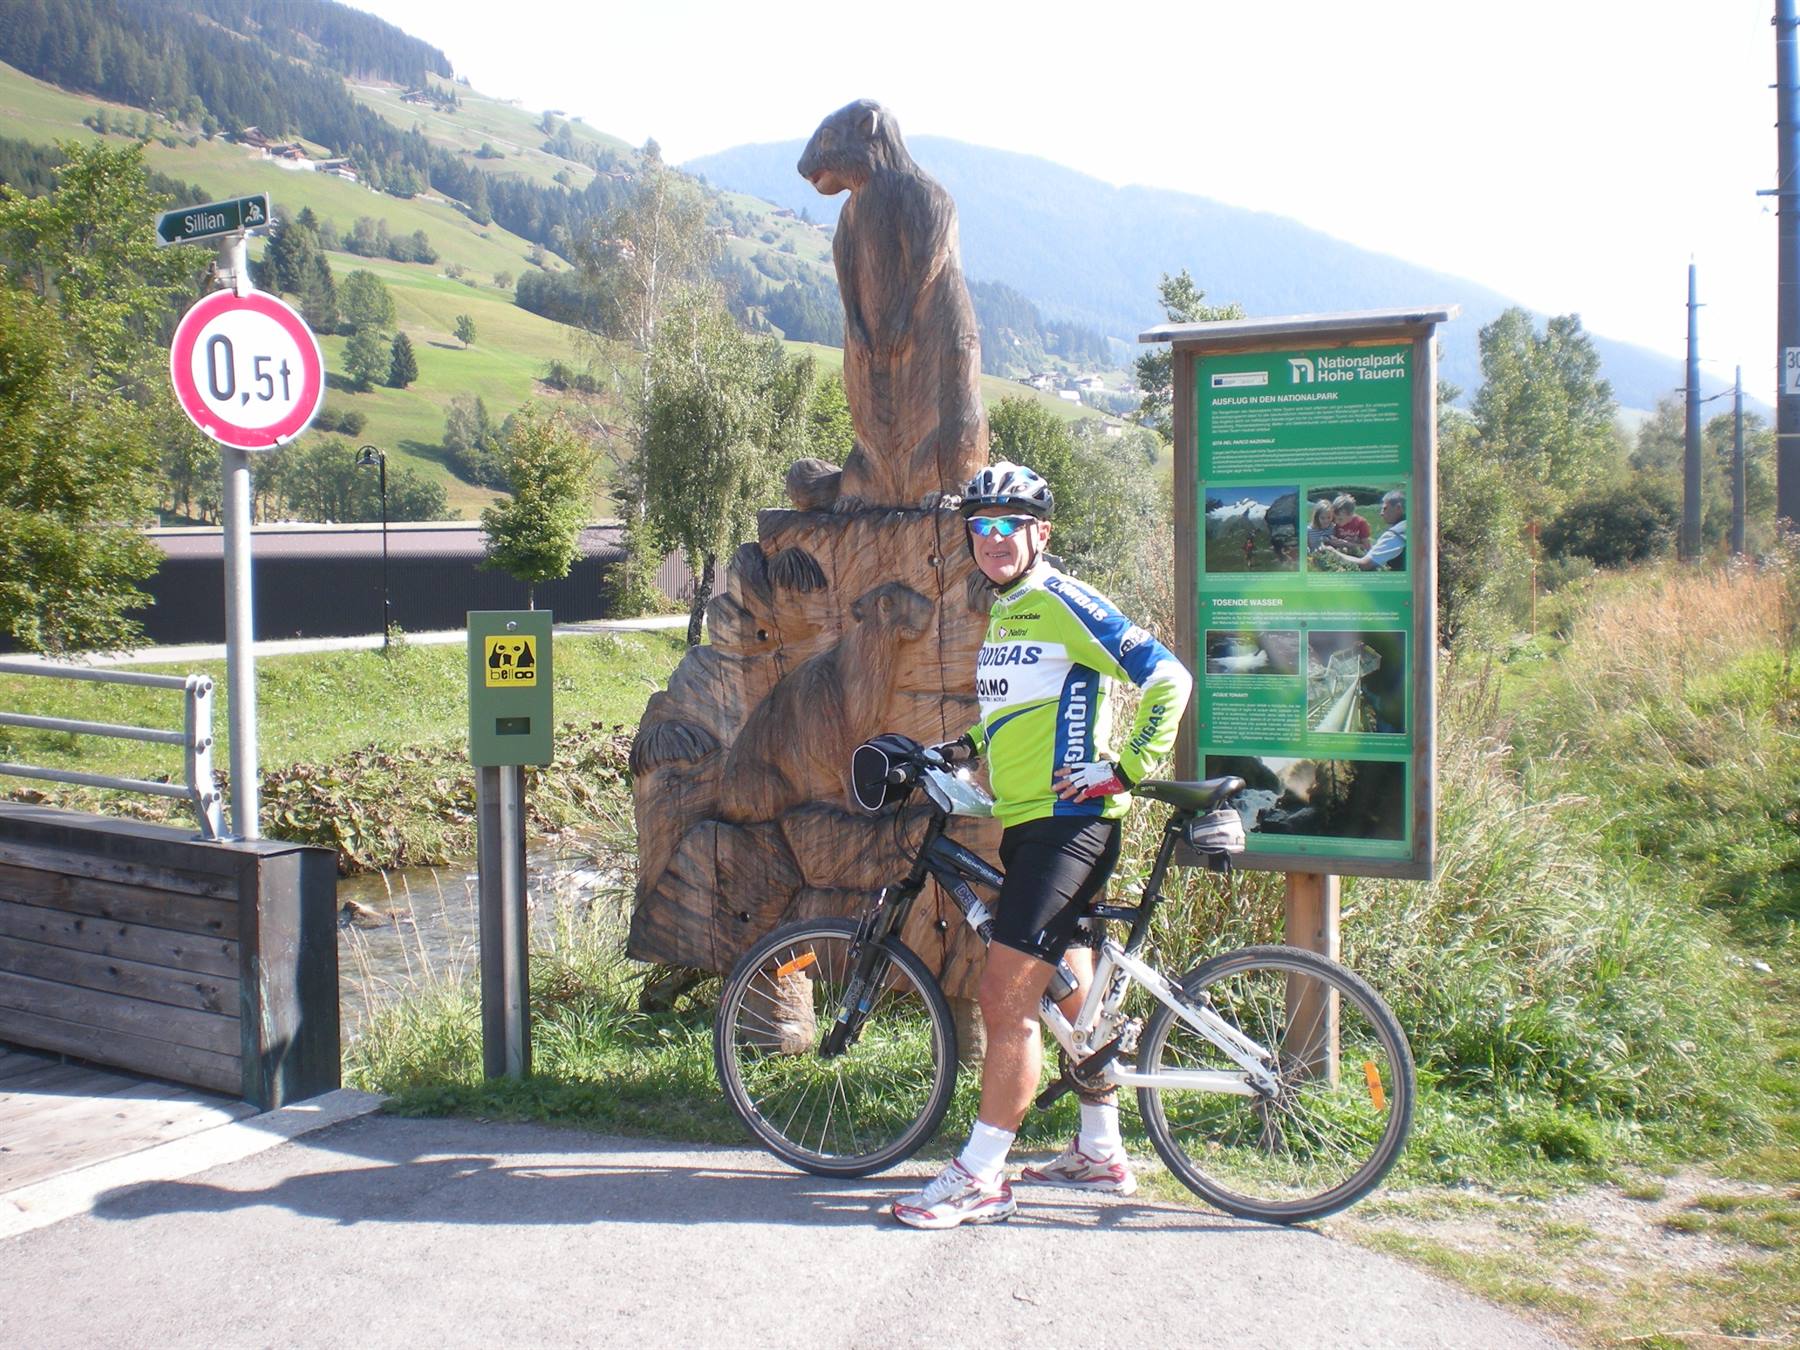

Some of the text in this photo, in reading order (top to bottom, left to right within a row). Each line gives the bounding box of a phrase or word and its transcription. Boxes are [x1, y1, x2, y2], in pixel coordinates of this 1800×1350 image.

[185, 211, 225, 234] Sillian
[1318, 352, 1405, 369] Nationalpark
[206, 333, 291, 407] 0,5t
[1317, 367, 1405, 382] Hohe Tauern
[1212, 392, 1338, 406] AUSFLUG IN DEN NATIONALPARK
[1212, 598, 1284, 607] TOSENDE WASSER
[490, 669, 534, 680] belloo
[1063, 681, 1087, 768] LIQUIG
